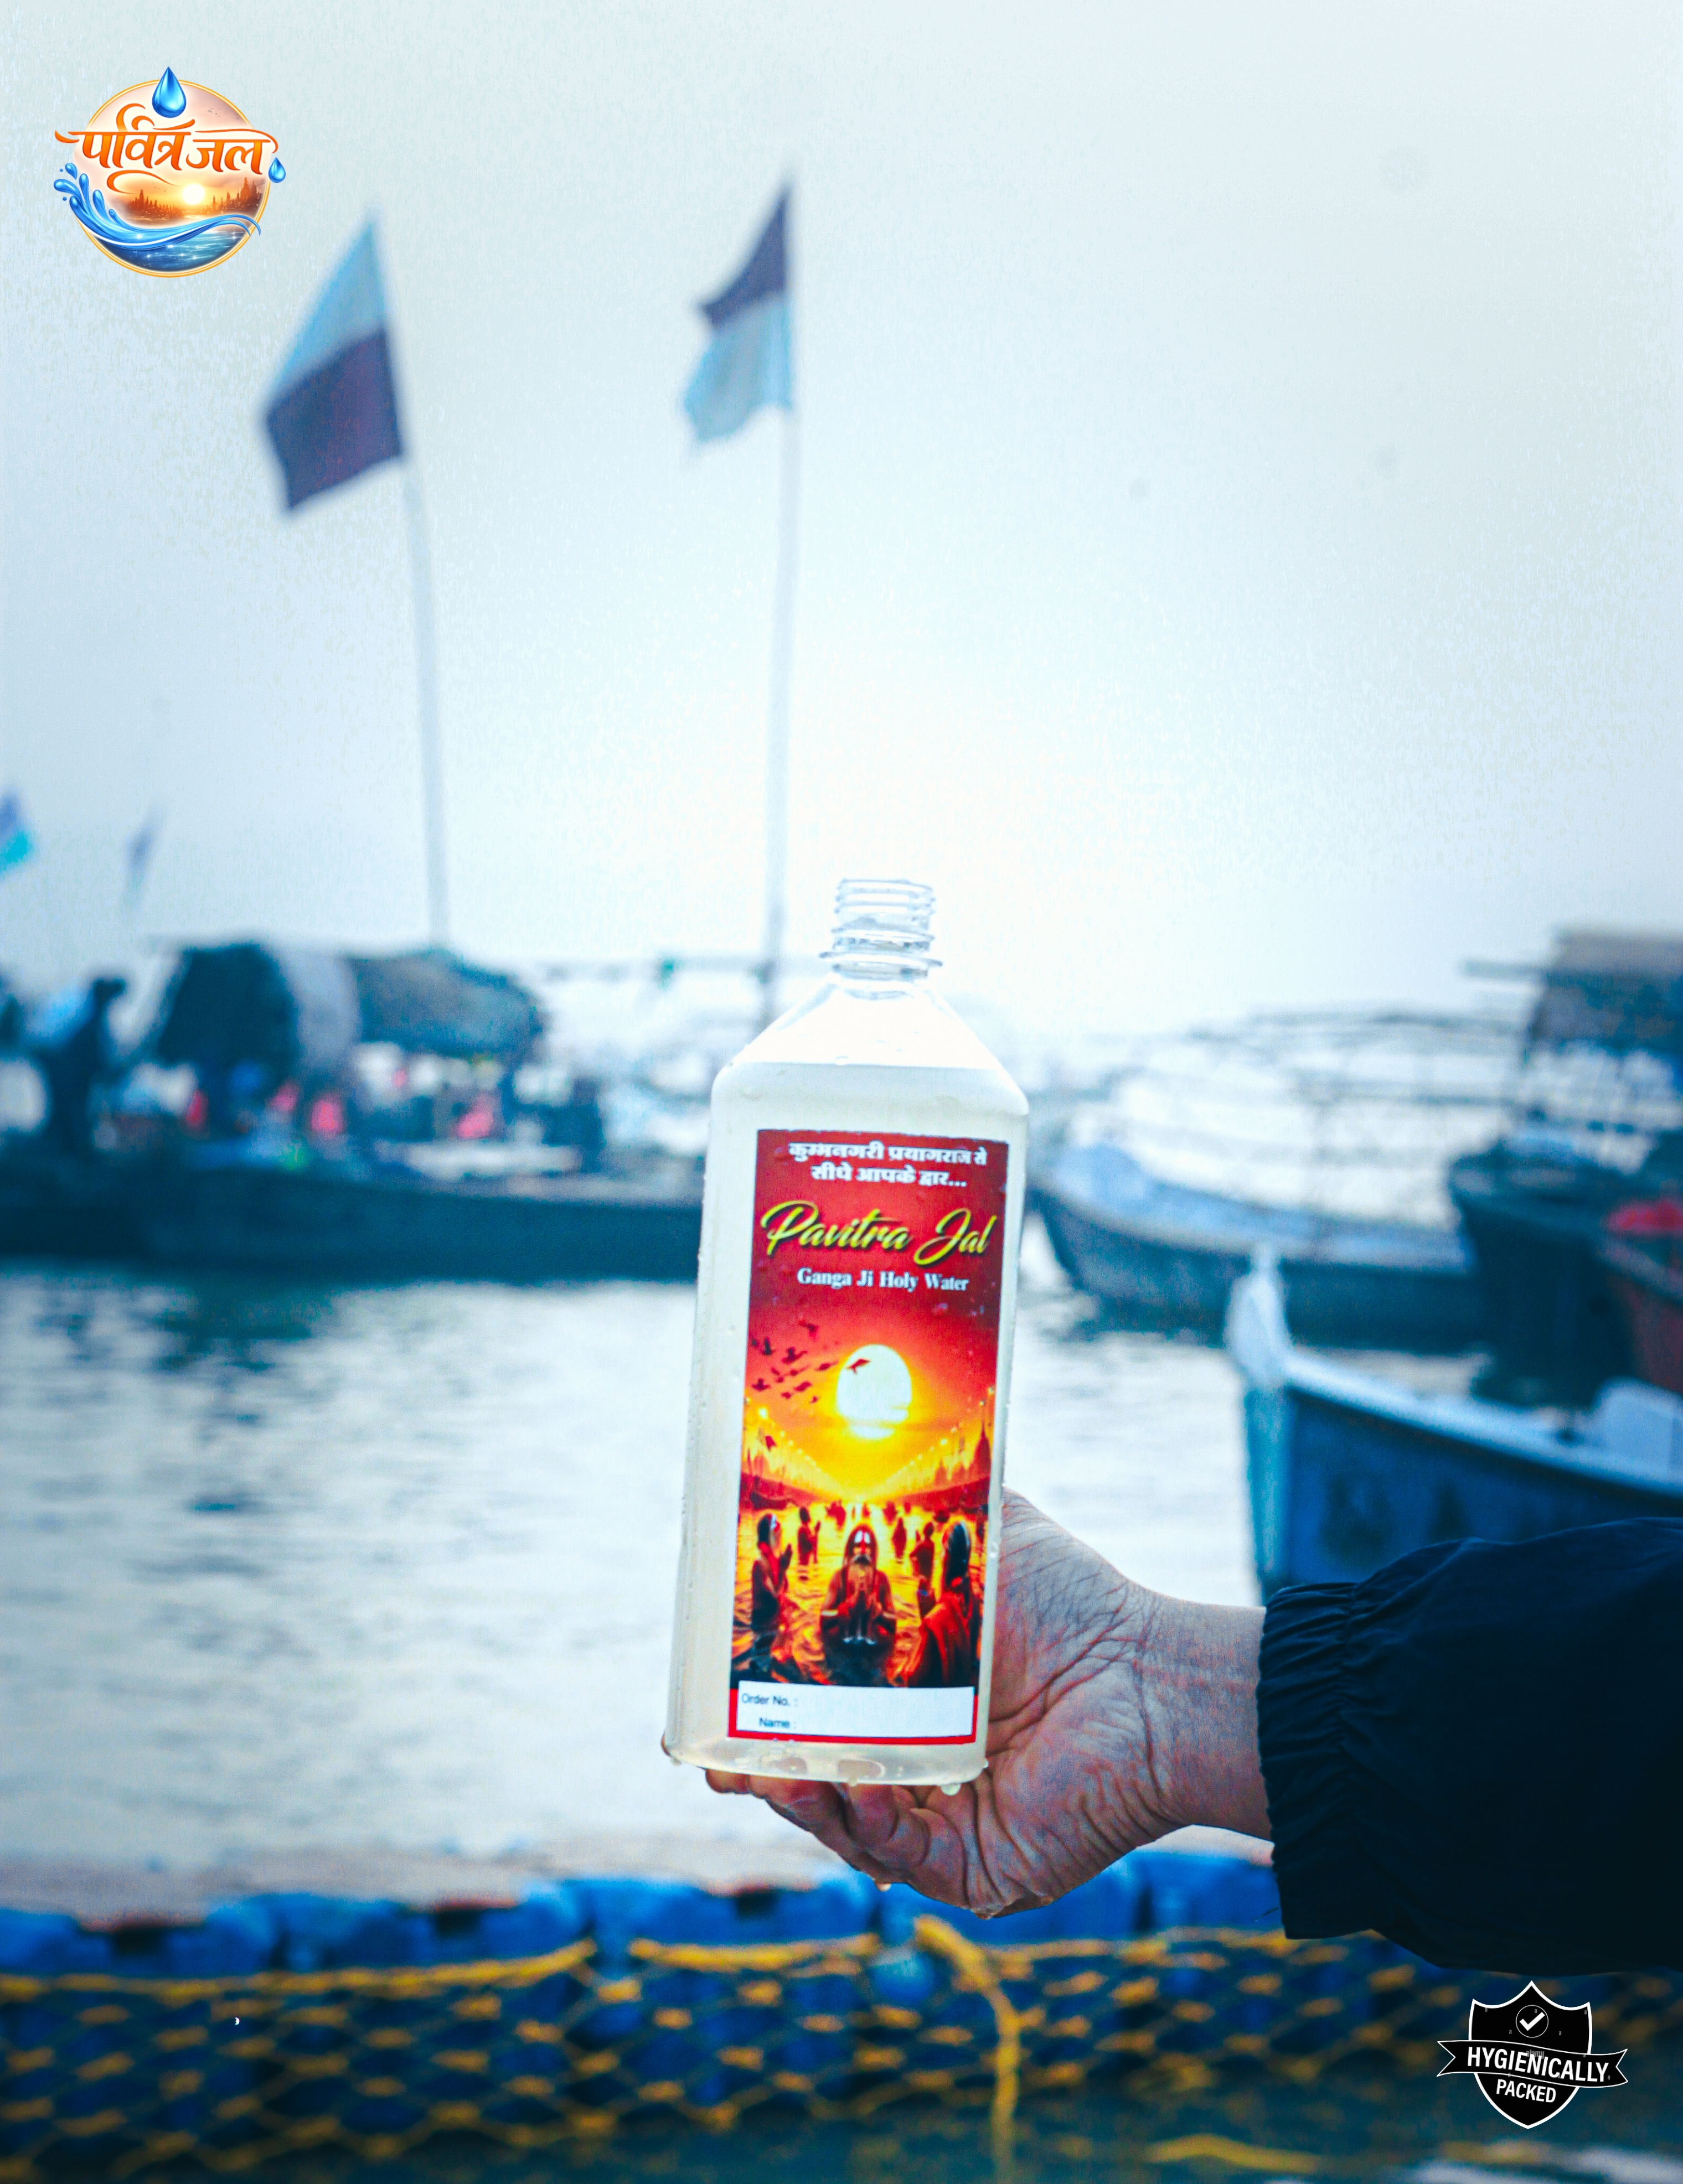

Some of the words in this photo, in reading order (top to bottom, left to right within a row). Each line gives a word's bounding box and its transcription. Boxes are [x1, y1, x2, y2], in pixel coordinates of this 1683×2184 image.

[888, 1146, 972, 1164] प्रयागराज
[974, 1146, 988, 1166] से
[856, 1164, 916, 1183] आपके
[761, 1200, 910, 1255] Pavitra
[914, 1208, 997, 1265] Jal
[797, 1267, 853, 1288] Ganga
[857, 1269, 874, 1286] Ji
[879, 1271, 918, 1292] Holy
[925, 1273, 969, 1291] Water
[742, 1693, 769, 1704] Order
[759, 1717, 790, 1728] Name
